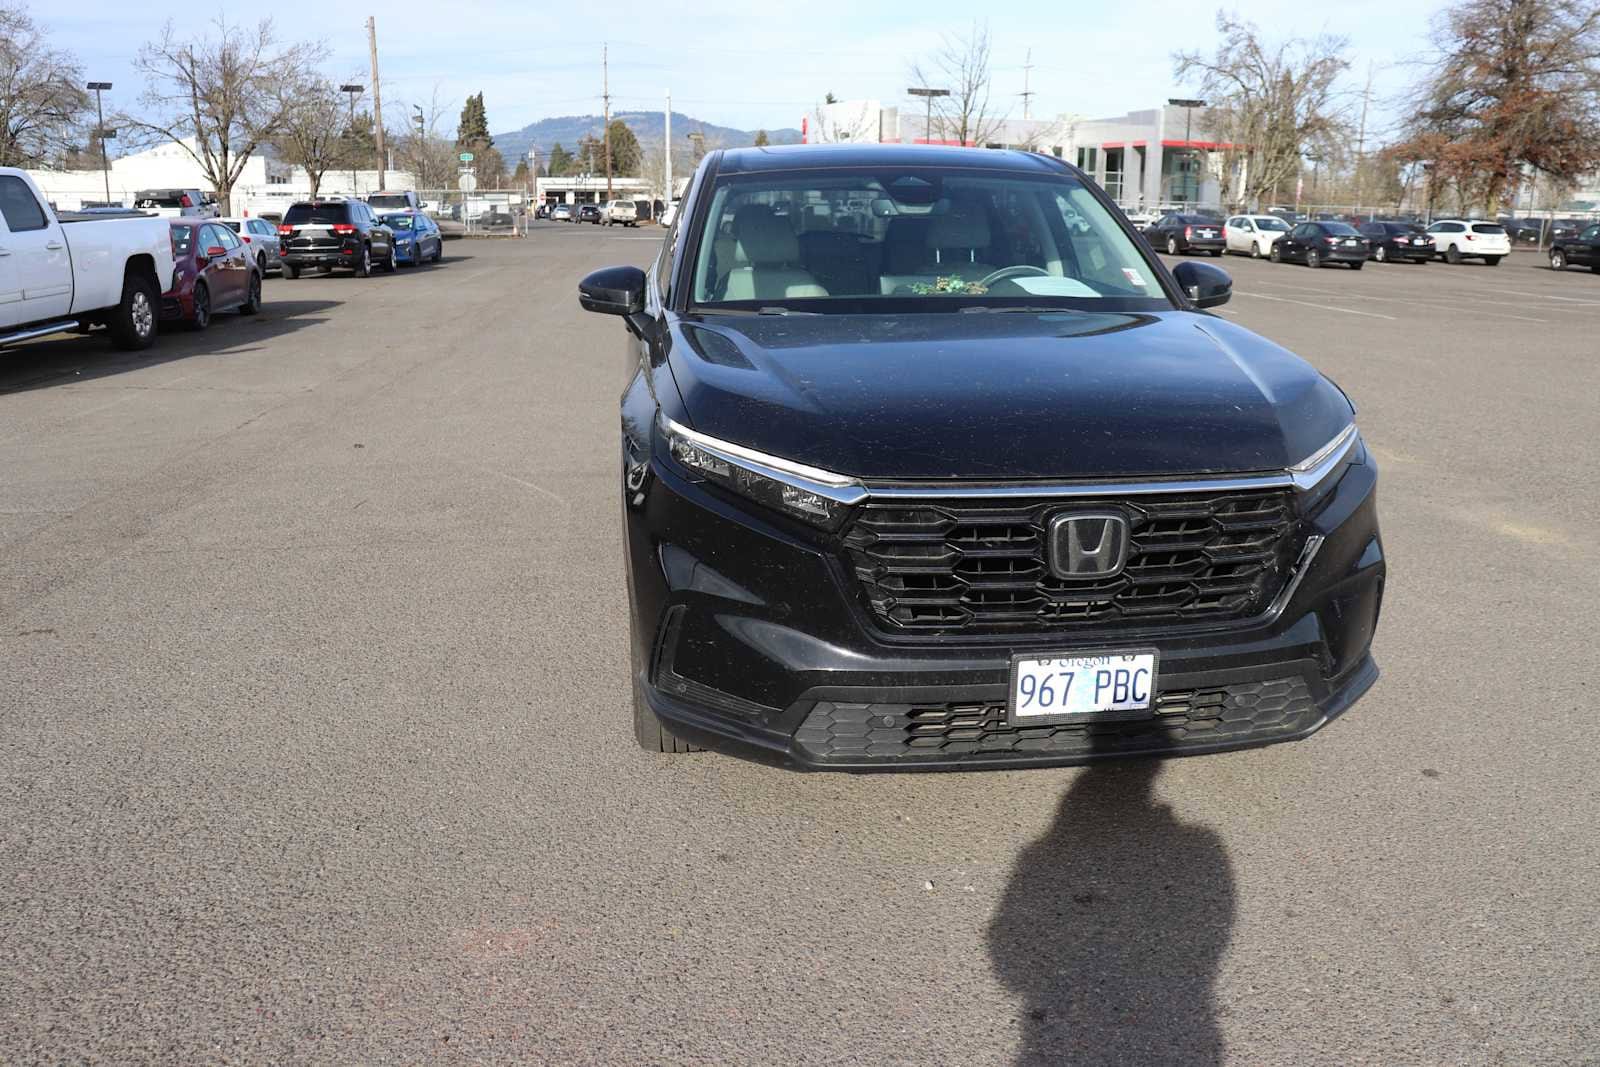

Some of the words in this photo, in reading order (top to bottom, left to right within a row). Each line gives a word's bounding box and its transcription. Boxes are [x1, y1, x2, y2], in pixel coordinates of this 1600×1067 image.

[1059, 656, 1110, 669] Oregon
[1020, 671, 1075, 708] 967
[1094, 668, 1149, 704] PBC
